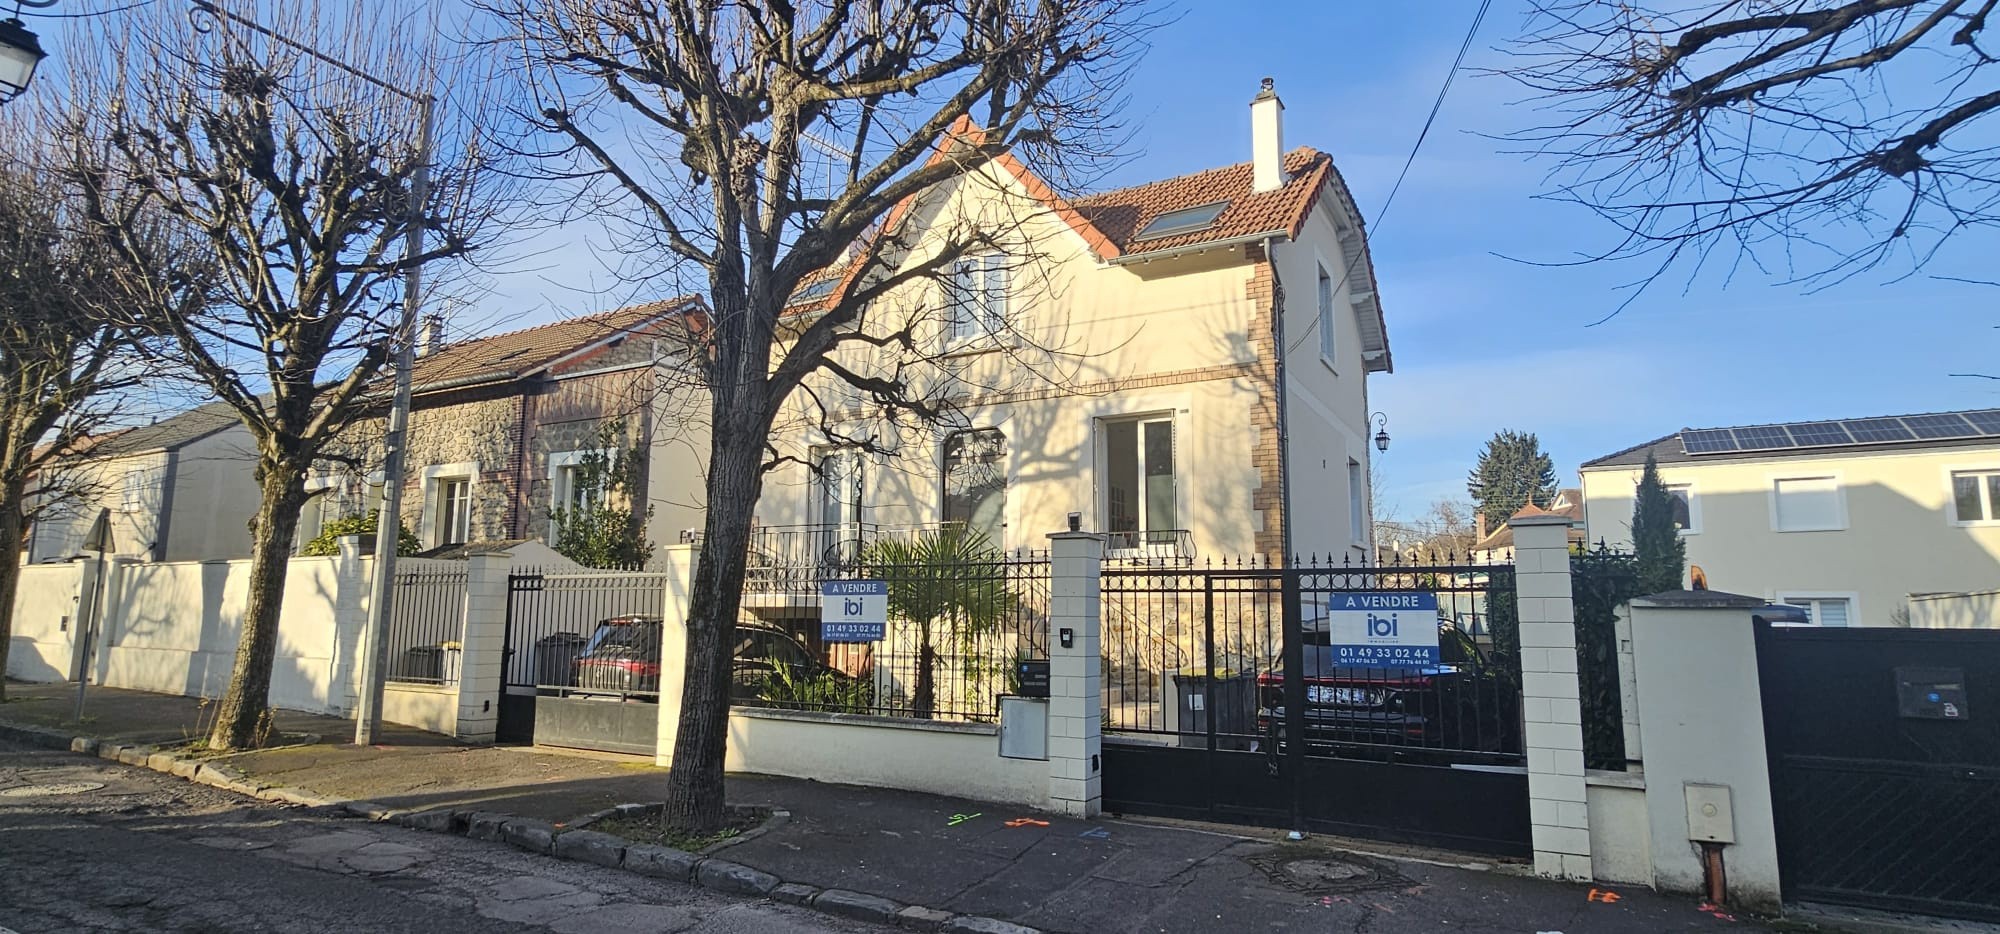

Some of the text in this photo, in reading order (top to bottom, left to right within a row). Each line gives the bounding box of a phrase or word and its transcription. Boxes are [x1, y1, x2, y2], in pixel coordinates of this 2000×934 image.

[832, 584, 877, 592] A VENDRE
[844, 597, 863, 615] ibi
[1346, 596, 1419, 607] A VENDRE
[1367, 613, 1398, 637] ibi
[1340, 648, 1430, 658] 01 49 33 02 44
